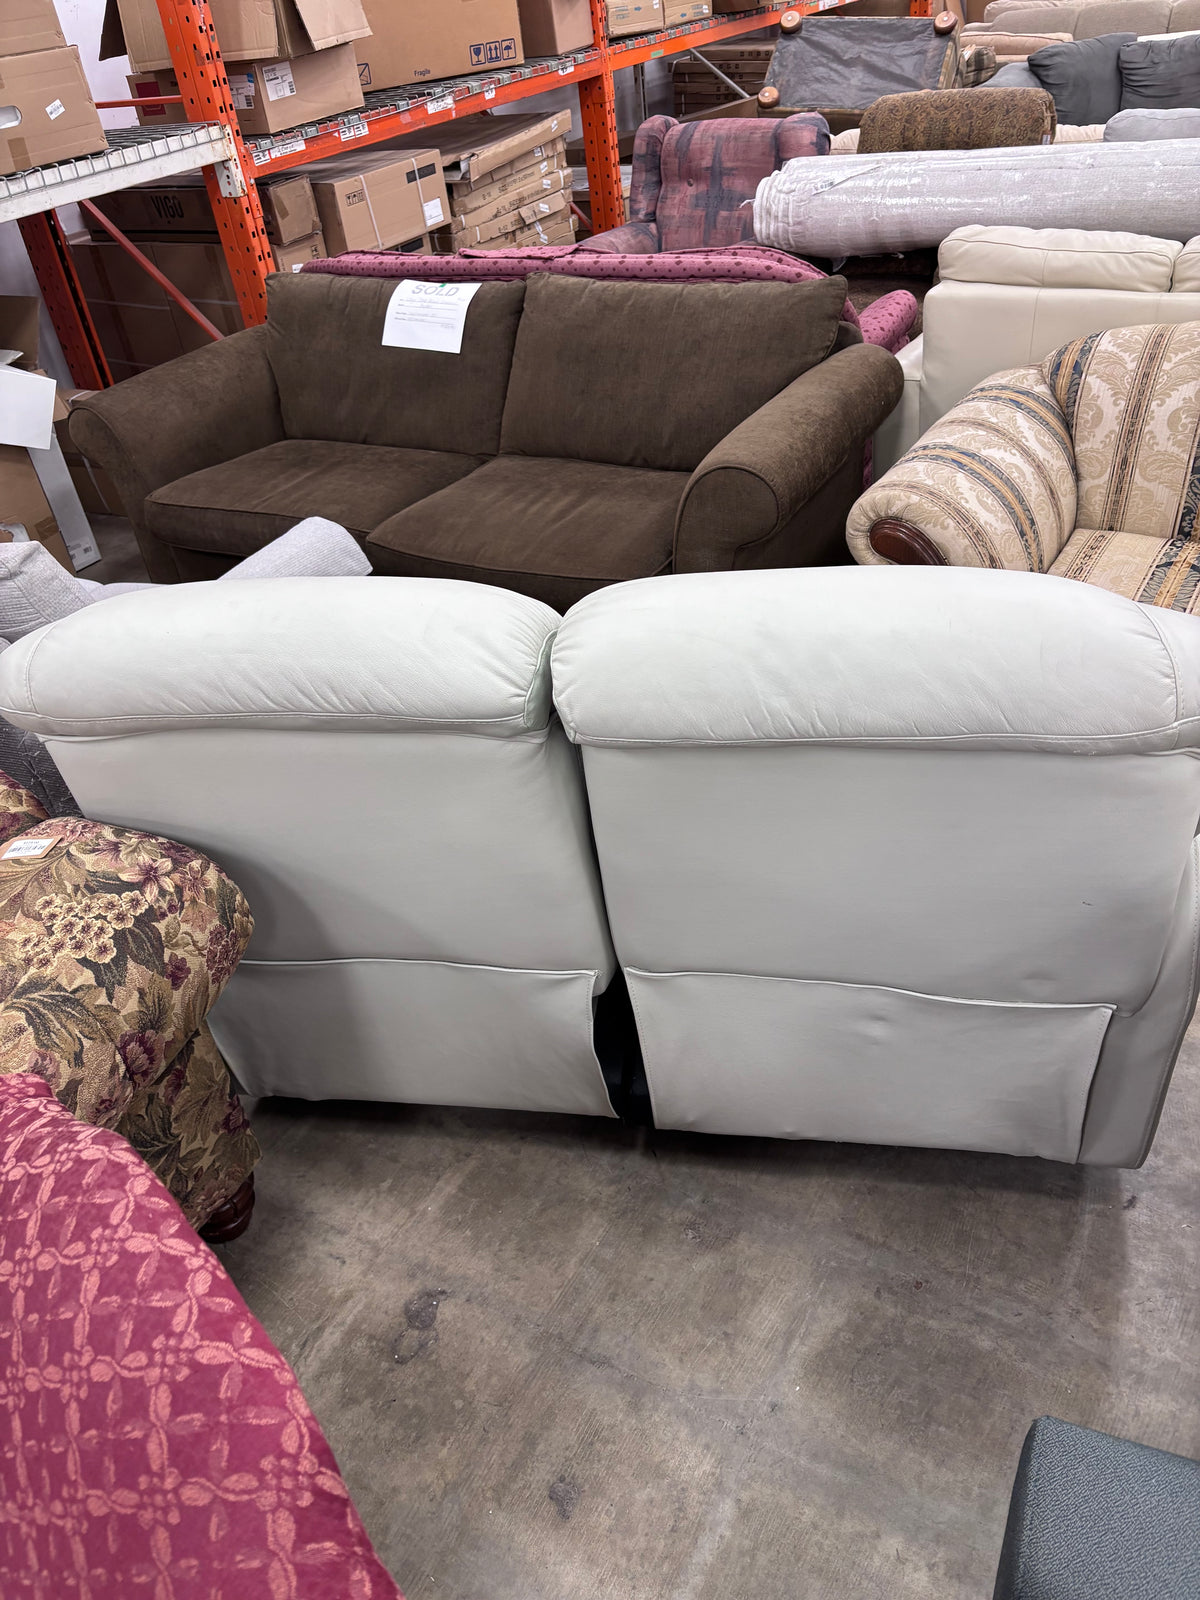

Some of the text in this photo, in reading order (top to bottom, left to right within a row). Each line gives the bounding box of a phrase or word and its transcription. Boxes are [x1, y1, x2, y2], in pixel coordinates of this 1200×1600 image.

[413, 69, 431, 77] Fragile
[150, 195, 184, 218] VIGO
[412, 284, 460, 297] SOLD
